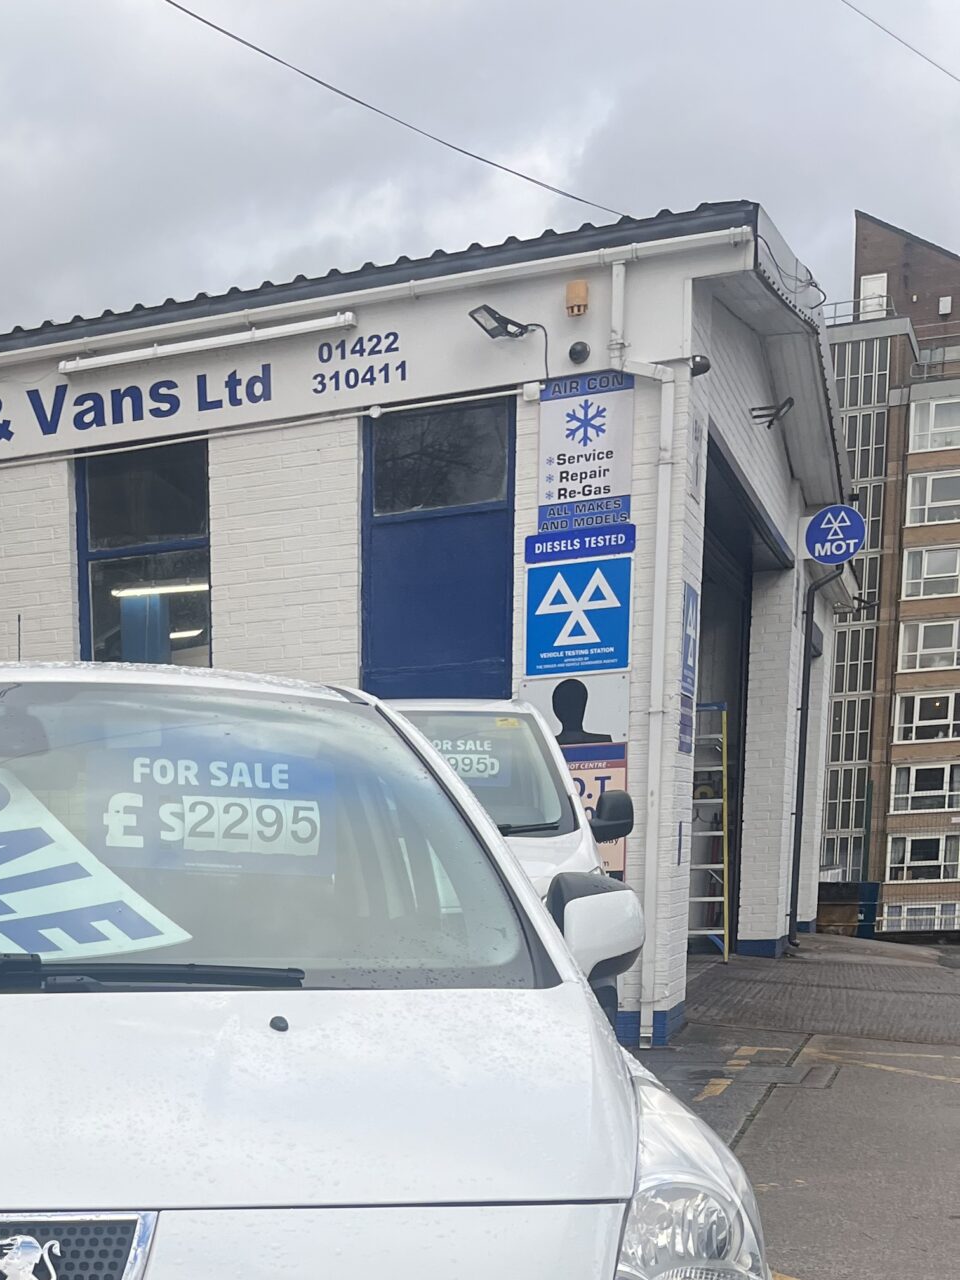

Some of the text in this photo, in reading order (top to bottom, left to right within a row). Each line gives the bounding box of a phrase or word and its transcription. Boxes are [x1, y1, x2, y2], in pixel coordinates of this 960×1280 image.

[318, 332, 400, 363] 01422
[312, 360, 406, 394] 310411
[551, 374, 624, 396] AIR CON
[26, 379, 181, 436] Vans
[196, 363, 272, 412] Ltd
[556, 449, 614, 465] Service
[559, 466, 610, 484] Repair
[557, 484, 611, 500] Re-Gas
[547, 500, 622, 518] ALL MAKES
[541, 512, 628, 532] AND MODELS
[534, 533, 626, 553] DIESELS TESTED
[814, 539, 859, 557] MOT
[540, 647, 614, 659] VEHICLE TESTING STATION
[432, 740, 493, 751] OR SALE
[133, 757, 289, 790] FOR SALE
[103, 792, 144, 848] £
